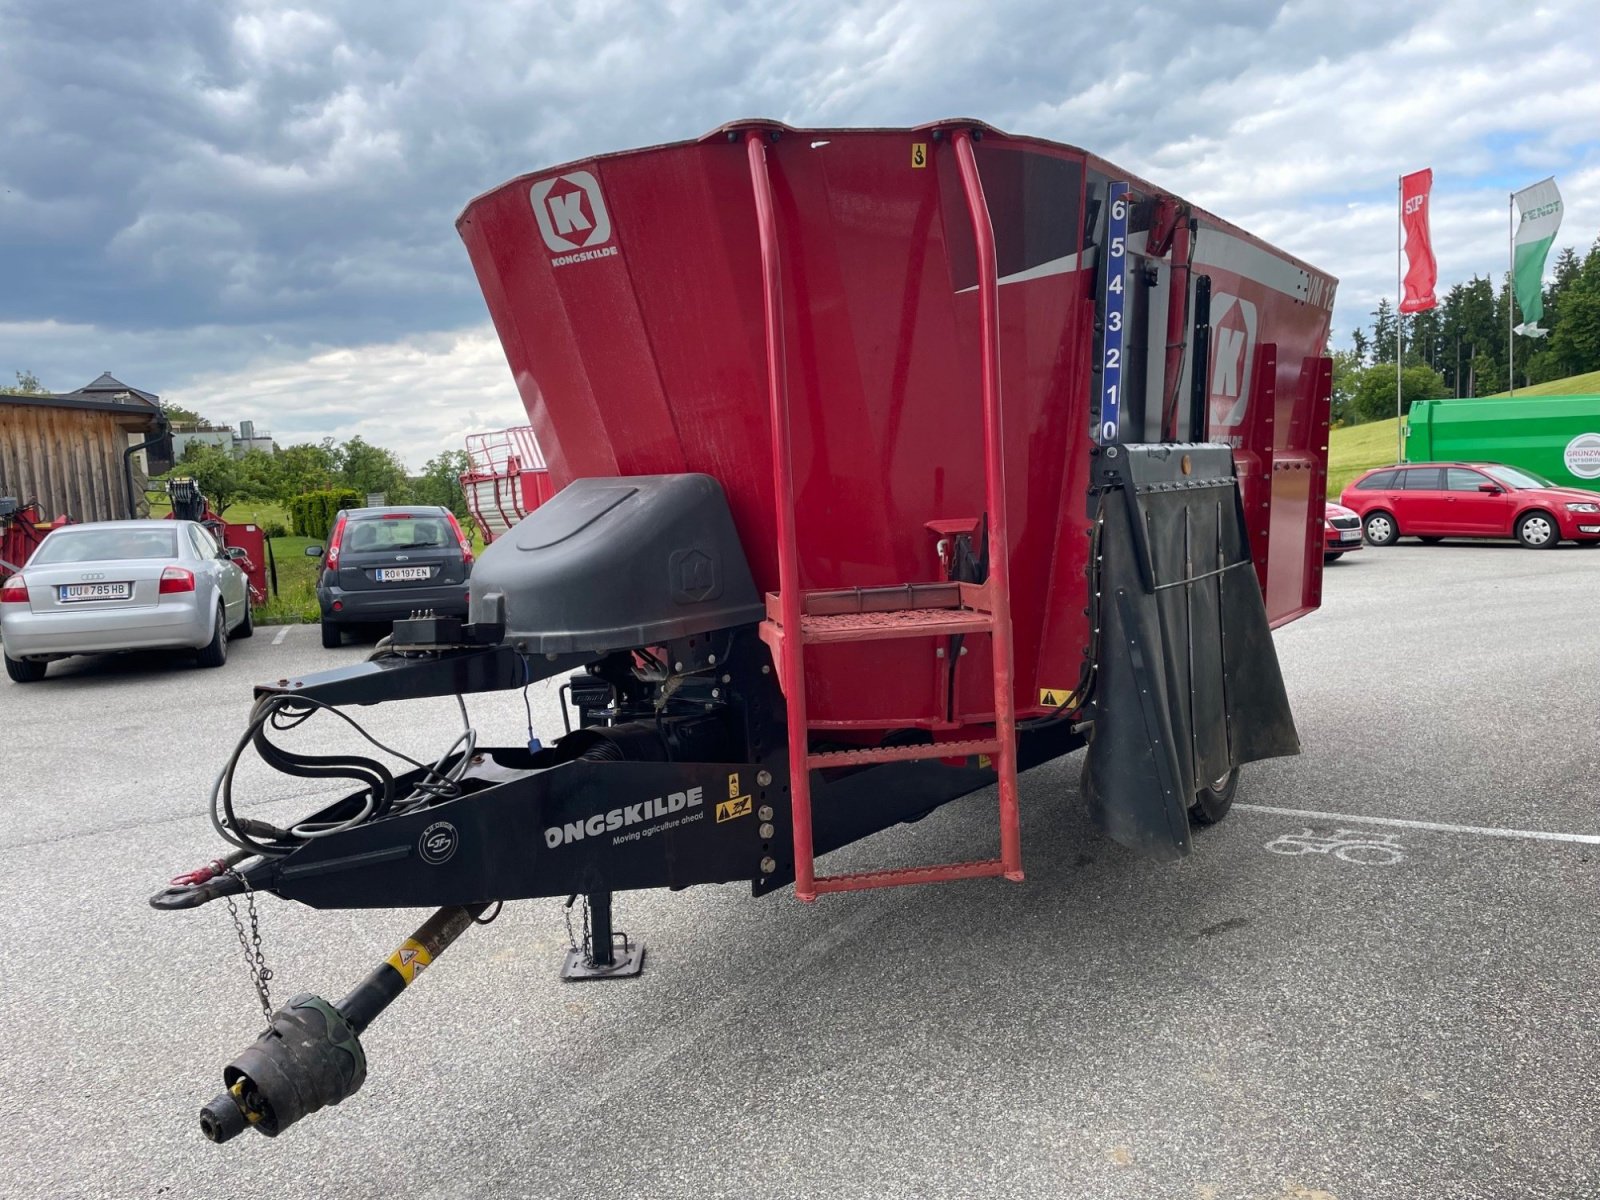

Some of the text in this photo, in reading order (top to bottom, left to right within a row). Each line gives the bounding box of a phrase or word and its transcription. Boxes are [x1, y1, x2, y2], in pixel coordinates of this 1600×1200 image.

[548, 191, 592, 235] K
[1111, 200, 1125, 221] 6
[1521, 200, 1560, 223] FENDT
[551, 246, 618, 267] KONGSKILDE
[1110, 238, 1124, 257] 5
[1108, 275, 1123, 294] 4
[1306, 273, 1325, 307] VM
[1108, 312, 1122, 331] 3
[1105, 349, 1120, 368] 2
[1106, 385, 1117, 404] 1
[1103, 421, 1116, 440] 0
[385, 570, 395, 578] RO
[417, 569, 427, 577] EN
[69, 584, 125, 596] UU 785 HB
[544, 786, 703, 849] ONGSKILDE
[612, 811, 704, 846] Moving agriculture ahead
